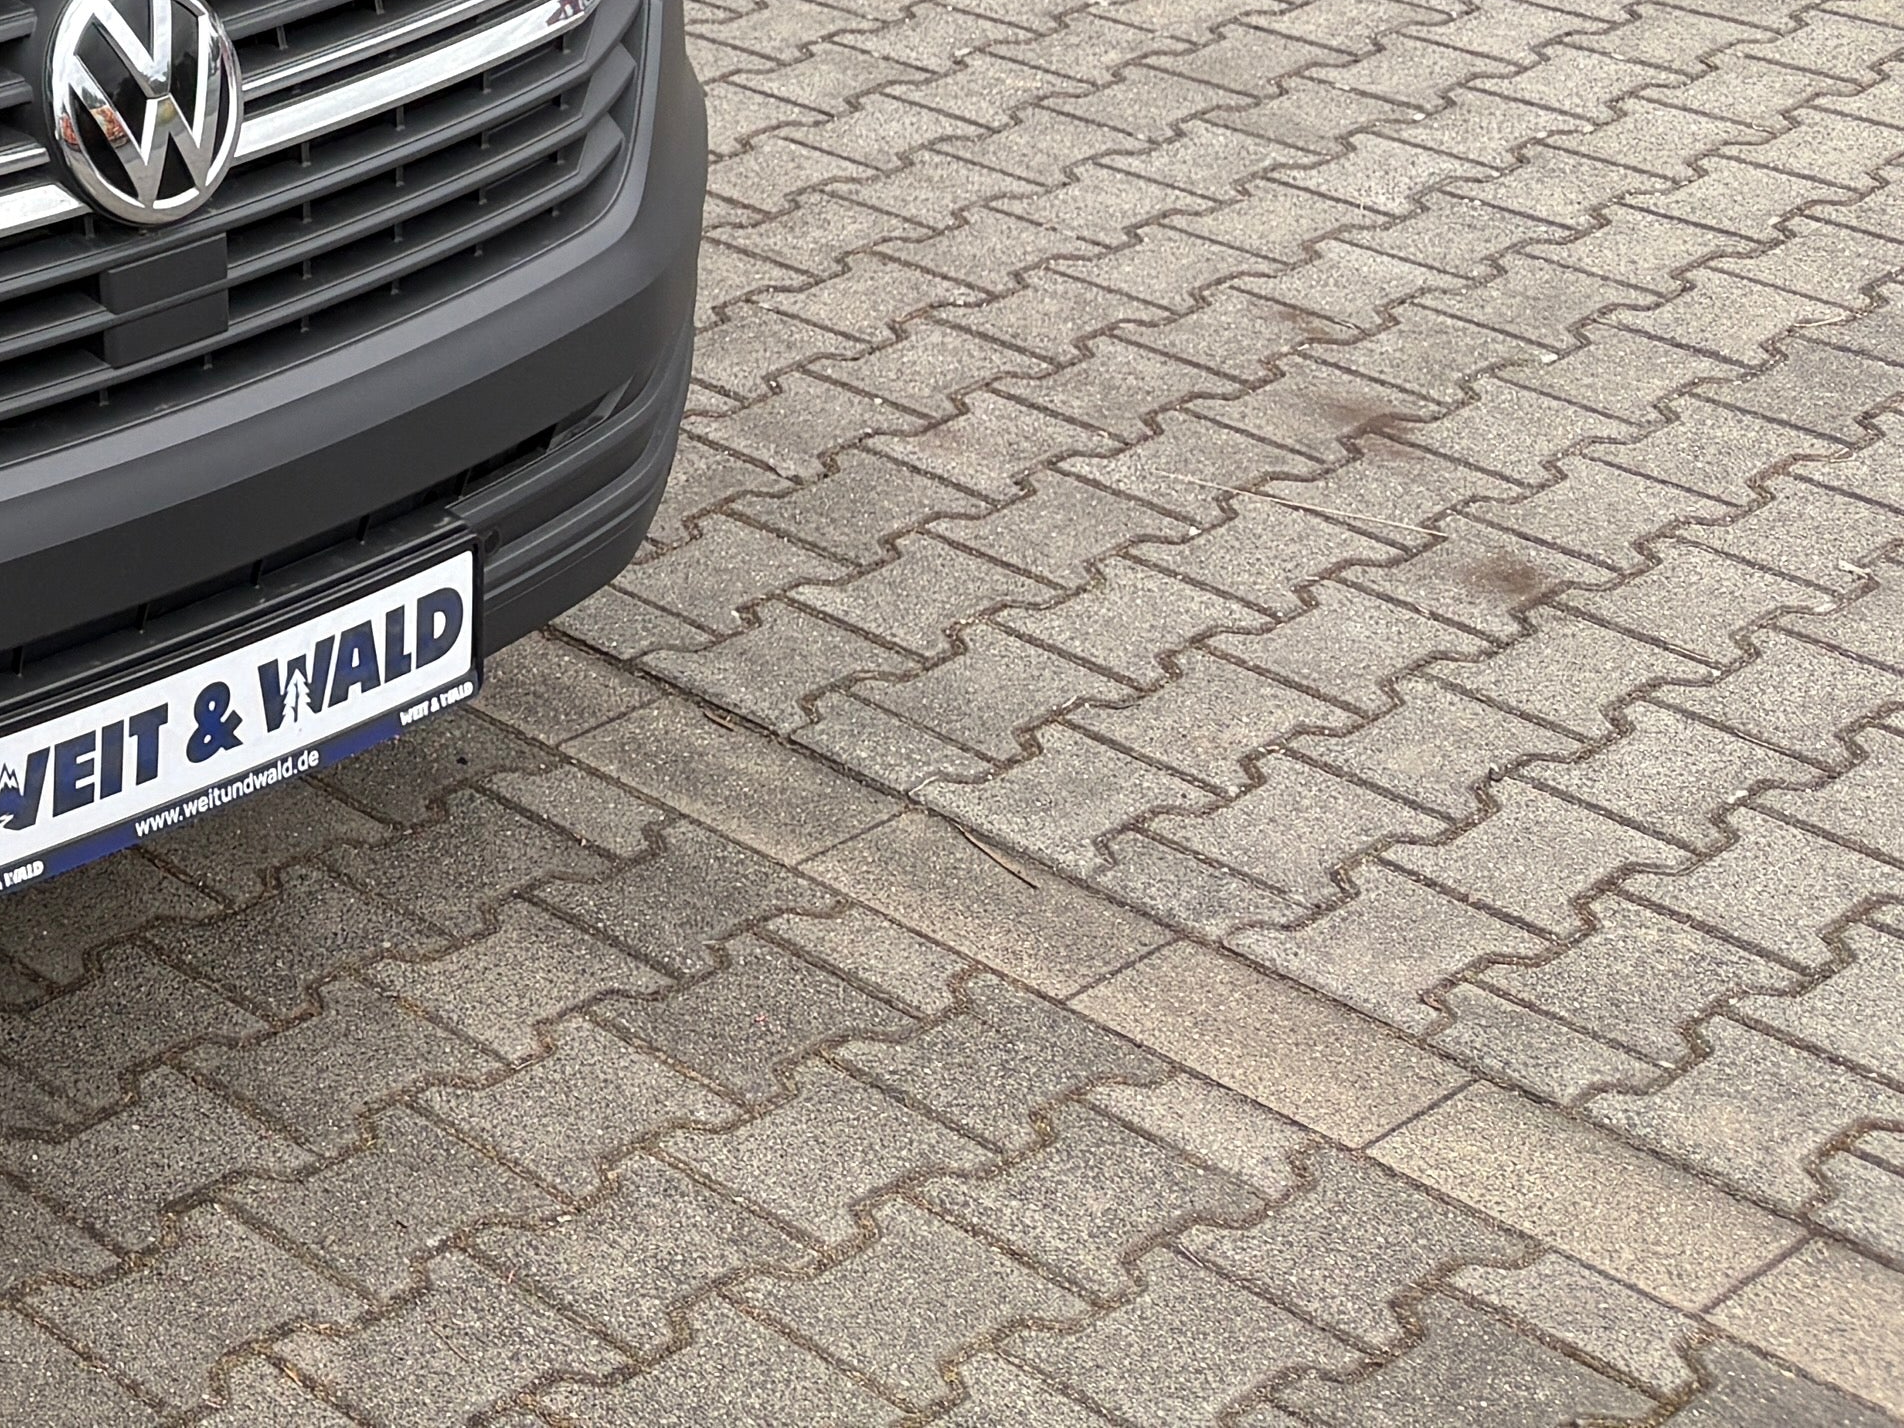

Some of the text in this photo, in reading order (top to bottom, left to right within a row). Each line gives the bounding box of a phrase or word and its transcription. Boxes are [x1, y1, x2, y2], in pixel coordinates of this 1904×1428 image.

[186, 680, 244, 764] &
[257, 586, 464, 734] WALD
[134, 748, 320, 837] www.weitundwald.de
